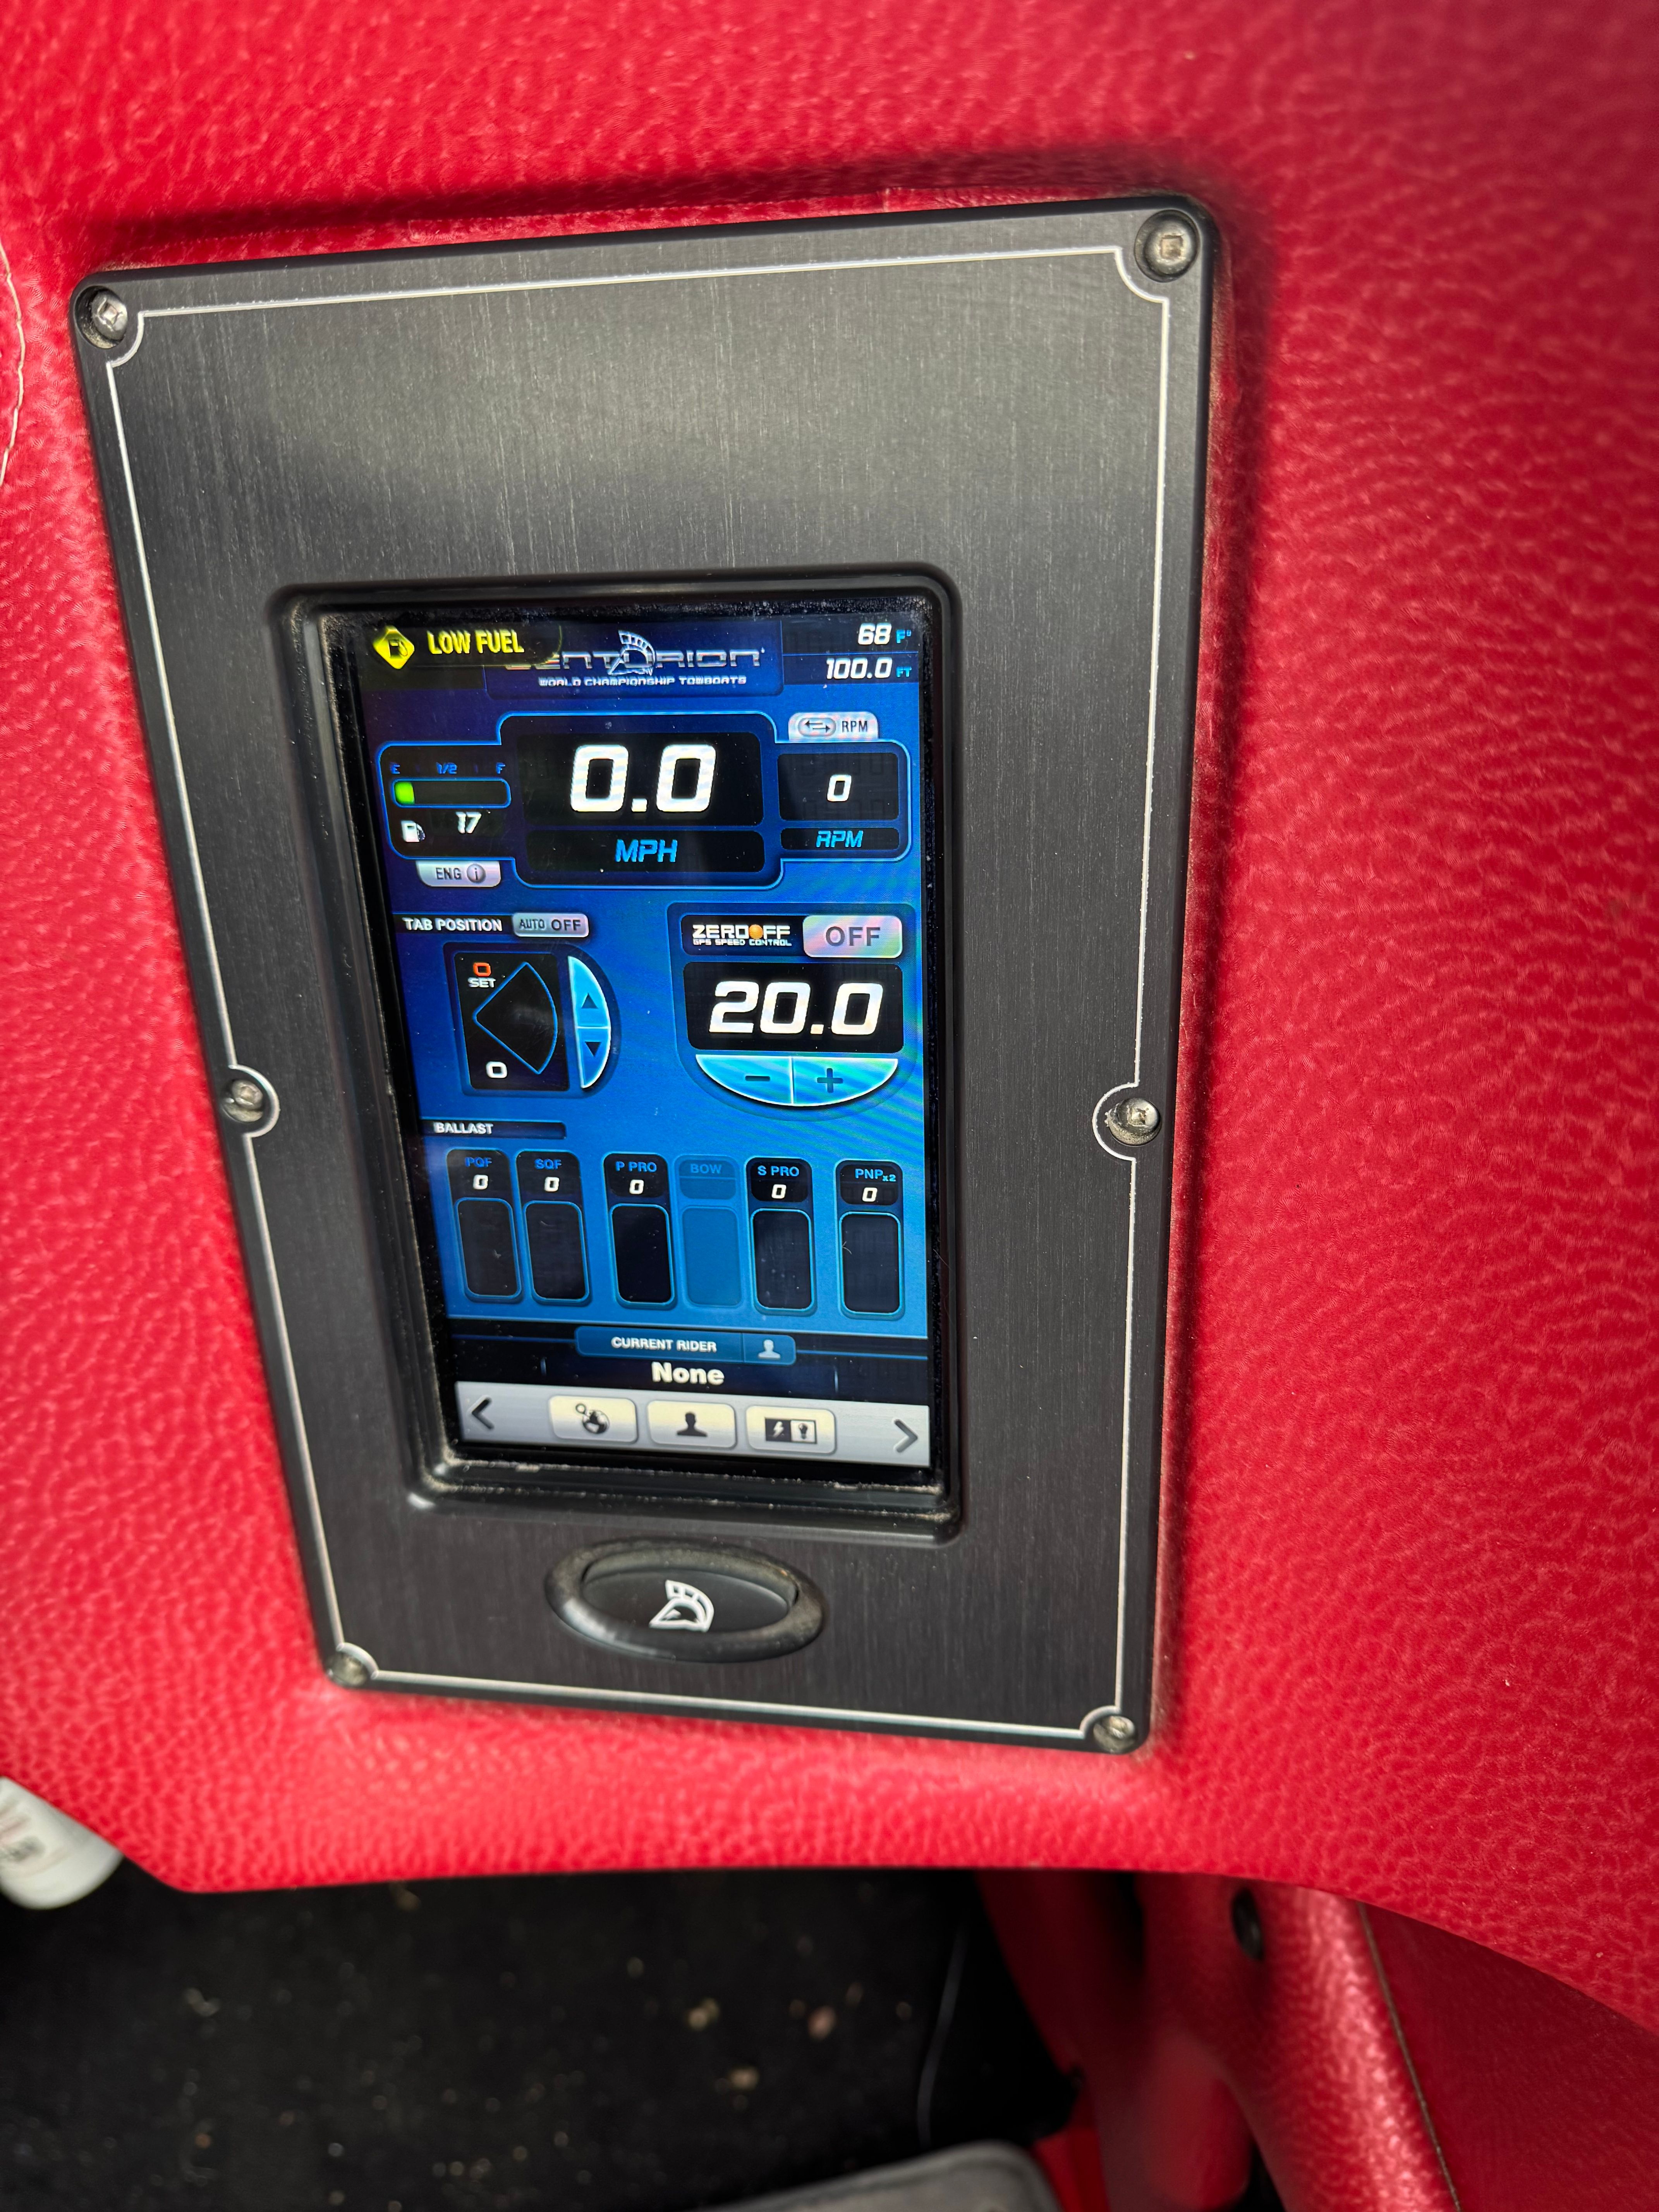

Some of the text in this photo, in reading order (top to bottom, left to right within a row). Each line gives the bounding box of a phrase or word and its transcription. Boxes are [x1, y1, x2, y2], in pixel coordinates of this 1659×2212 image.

[858, 622, 892, 645] 68
[427, 629, 524, 654] LOW FUEL
[826, 657, 912, 679] 100.0 FT
[538, 675, 746, 687] WORLD CHAMPIONSHIP TOWBOATS
[842, 720, 868, 733] RPM
[390, 762, 505, 774] E 1/2 F
[570, 744, 716, 812] 0.0
[827, 775, 852, 802] 0
[456, 811, 482, 833] 17
[816, 830, 864, 848] RPM
[615, 839, 677, 862] MPH
[436, 867, 462, 880] ENG
[402, 917, 502, 931] TAB POSITION
[520, 919, 581, 931] AUTO OFF
[826, 926, 881, 947] OFF
[473, 962, 491, 977] 0
[468, 977, 496, 988] SET
[709, 981, 884, 1035] 20.0
[486, 1061, 508, 1079] 0
[433, 1122, 493, 1135] BALLAST
[465, 1157, 492, 1168] PQF
[535, 1158, 562, 1170] SQF
[615, 1162, 657, 1173] P PRO
[690, 1164, 722, 1174] BOW
[757, 1166, 799, 1177] S PRO
[472, 1174, 489, 1190] 0
[544, 1176, 560, 1192] 0
[629, 1179, 644, 1195] 0
[771, 1184, 787, 1199] 0
[862, 1187, 878, 1202] 0
[611, 1336, 717, 1353] CURRENT RIDER
[651, 1362, 725, 1385] None
